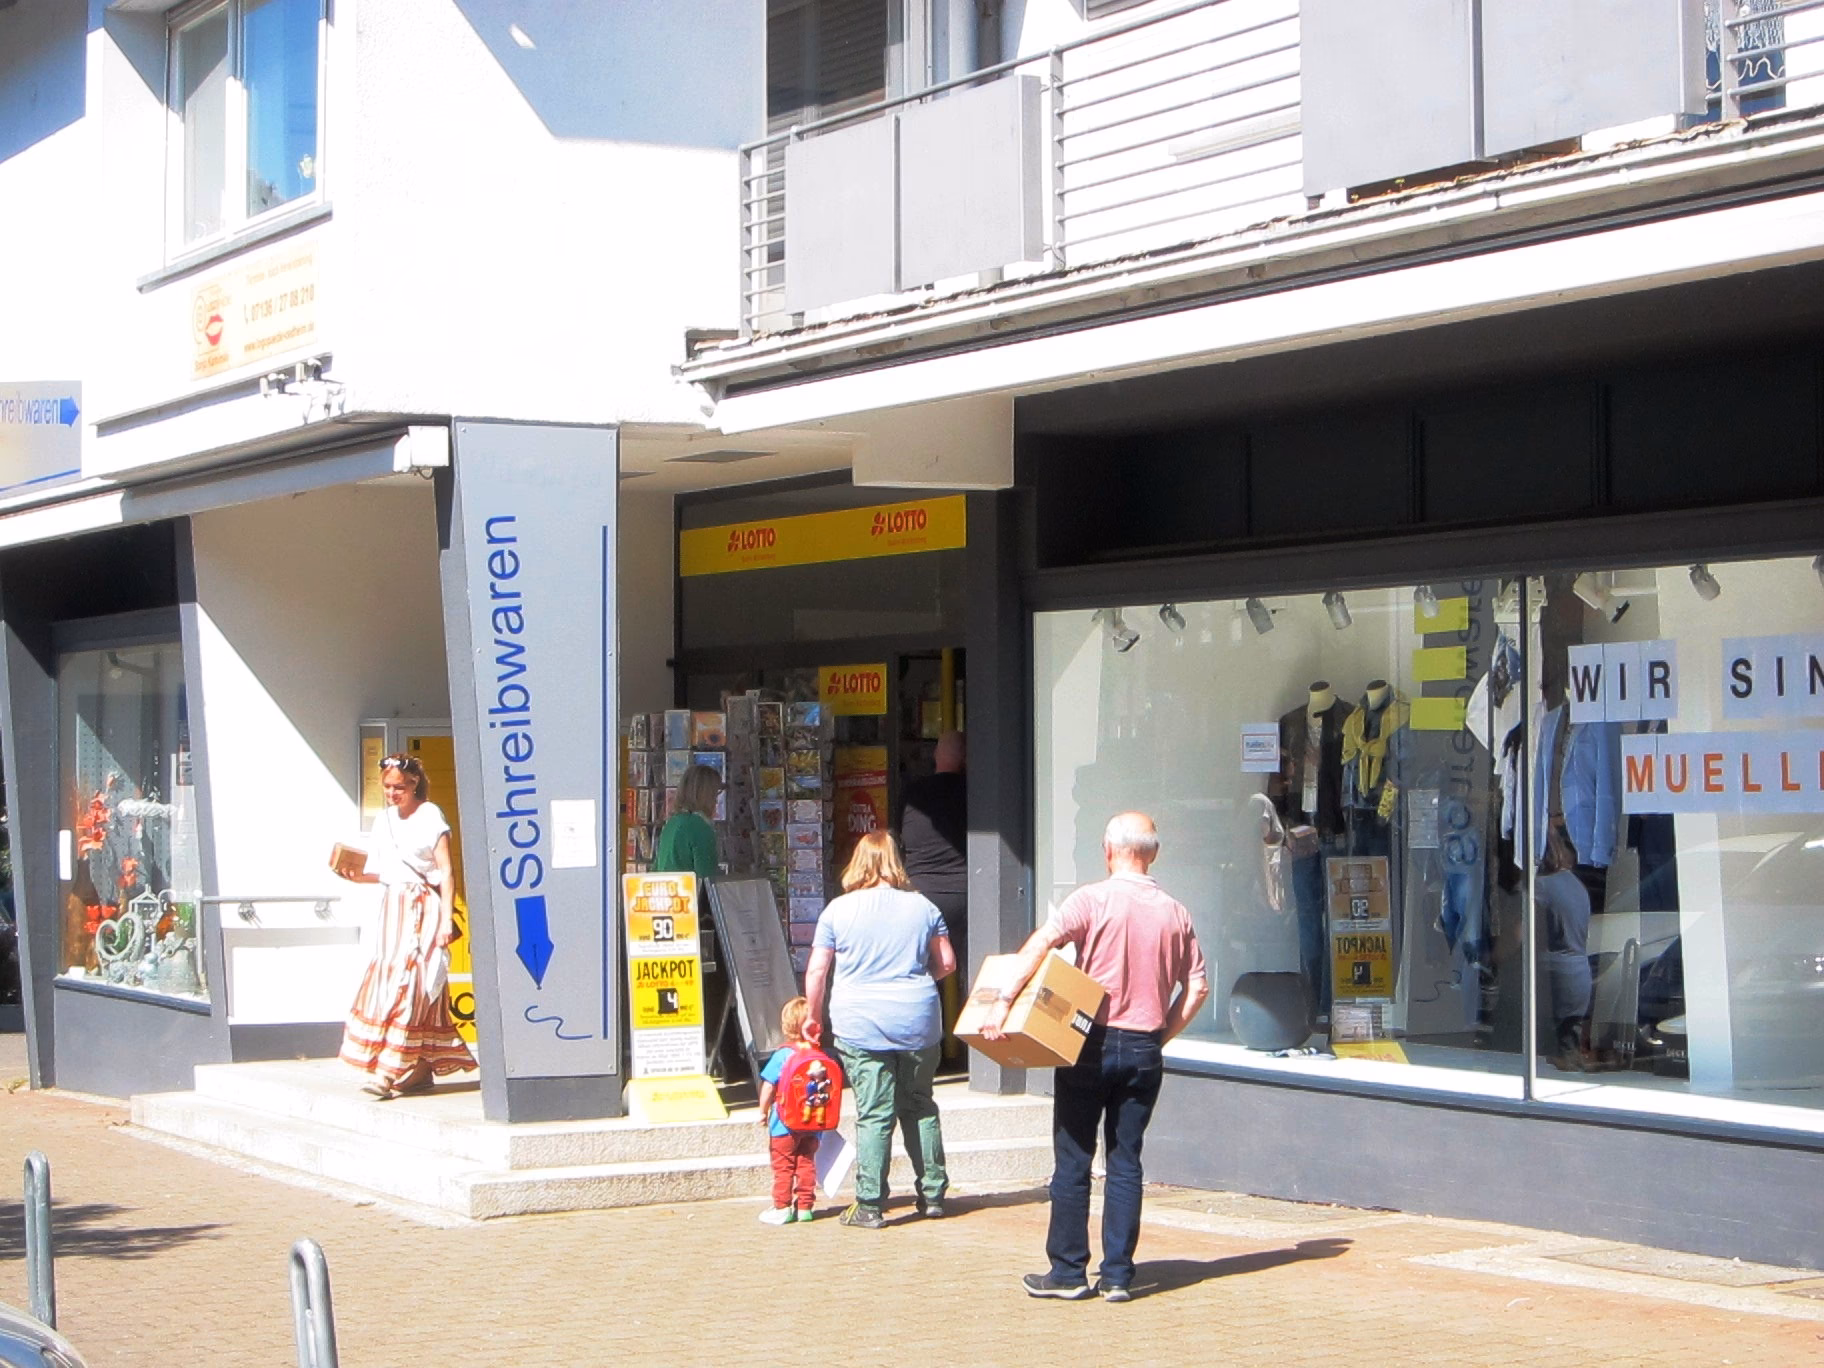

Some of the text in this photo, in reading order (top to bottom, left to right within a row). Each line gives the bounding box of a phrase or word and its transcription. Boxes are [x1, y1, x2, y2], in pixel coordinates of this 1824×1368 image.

[887, 508, 926, 533] LOTTO
[741, 527, 776, 550] LOTTO
[843, 671, 881, 693] LOTTO
[1571, 655, 1824, 703] WIR SIN
[485, 515, 543, 889] Schreibwaren
[1627, 751, 1824, 793] MUELL
[643, 880, 678, 897] EURO
[632, 895, 690, 914] JACKPOT
[653, 918, 673, 939] 90
[637, 960, 694, 981] JACKPOT
[666, 991, 679, 1009] 4
